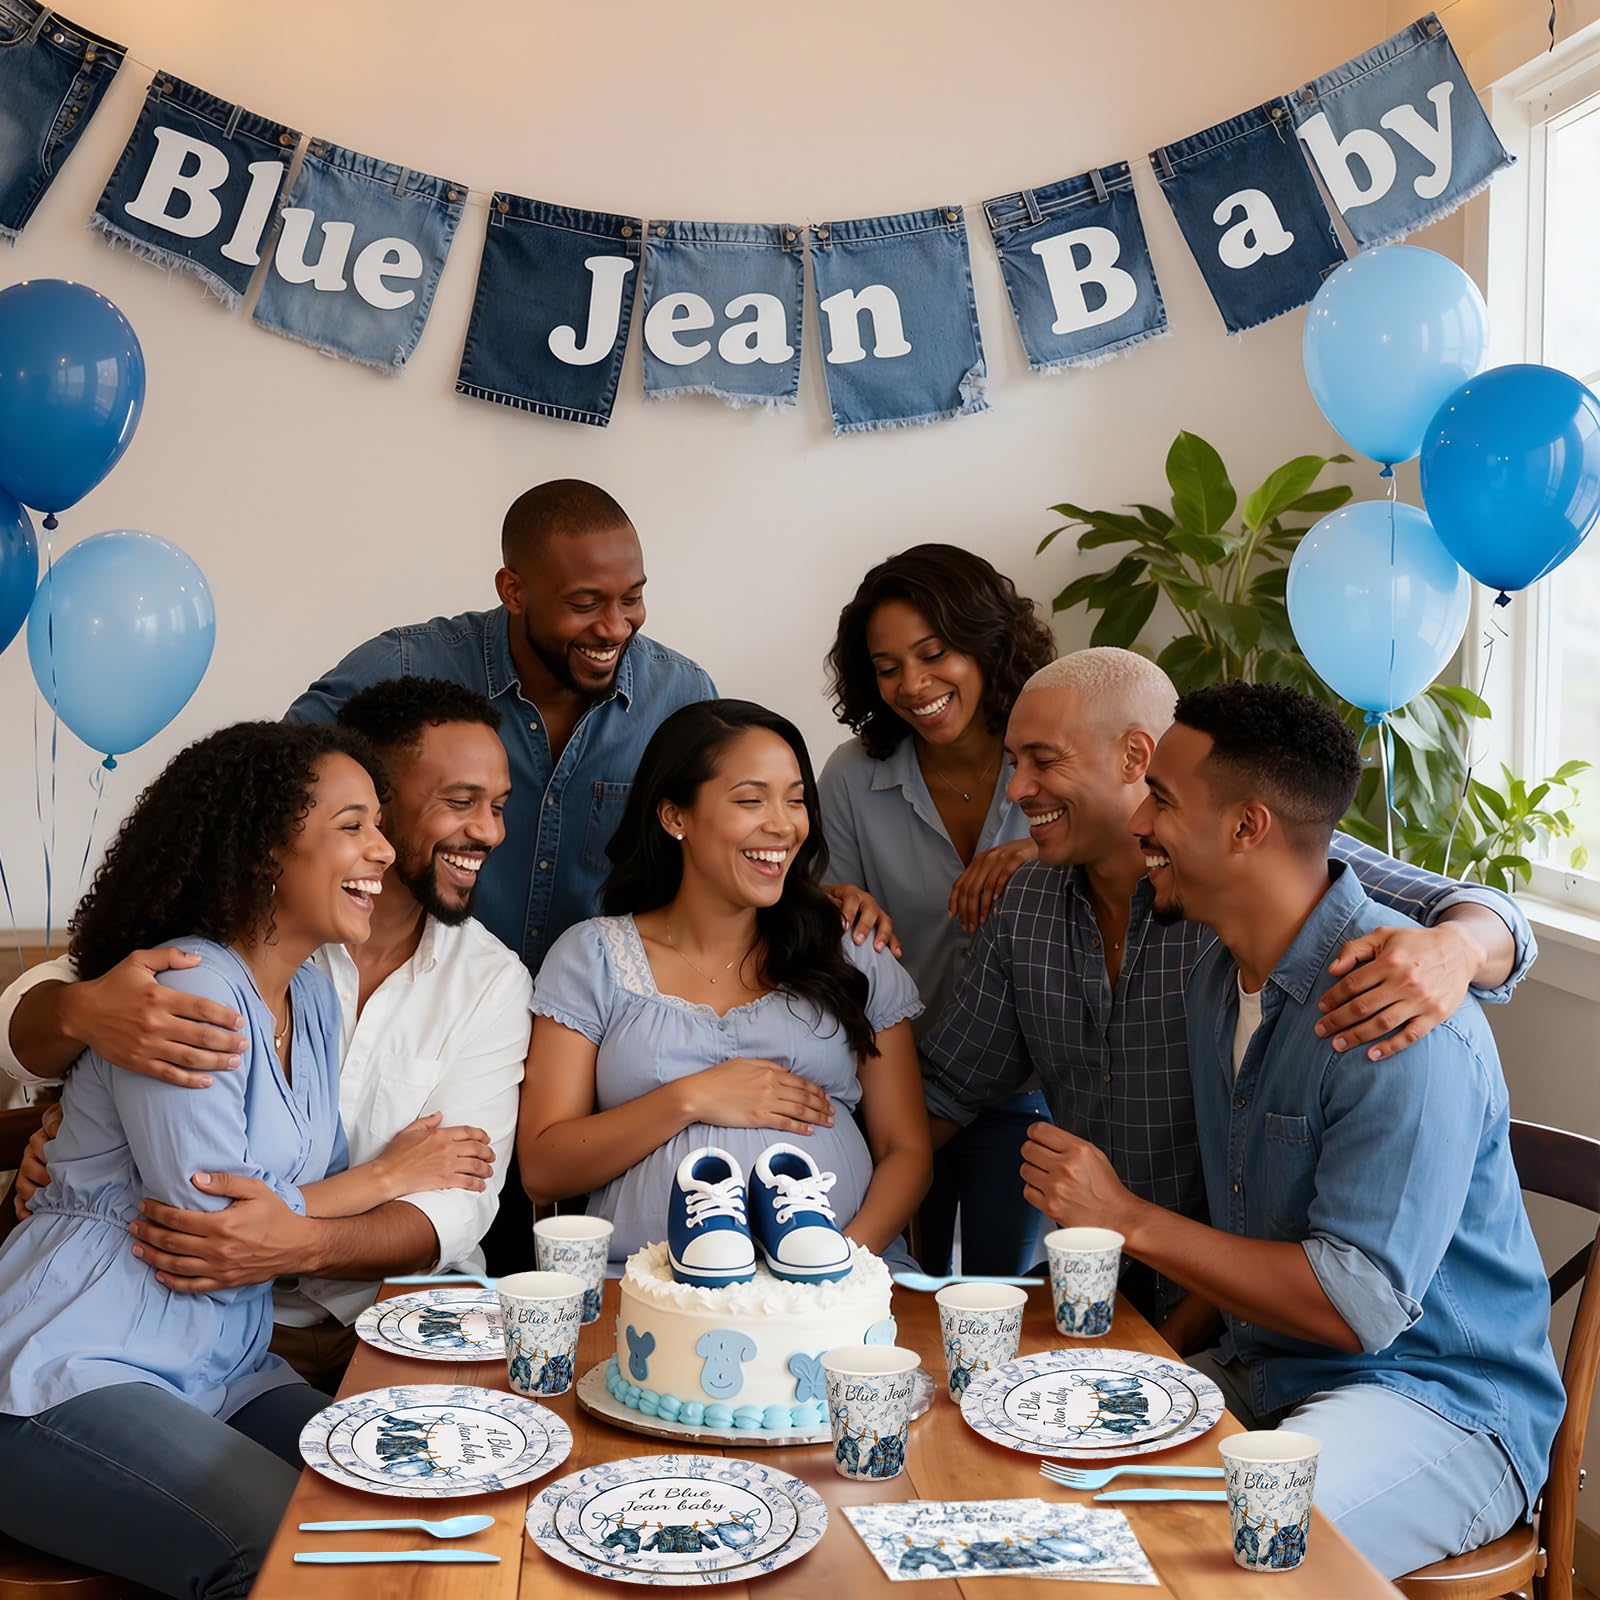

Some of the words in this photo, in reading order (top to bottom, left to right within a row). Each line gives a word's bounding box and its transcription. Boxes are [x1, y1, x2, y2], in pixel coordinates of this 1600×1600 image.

[124, 126, 424, 310] Blue
[548, 255, 912, 366] Jean
[1031, 81, 1454, 336] Baby
[553, 1247, 581, 1262] Blue
[1064, 1259, 1090, 1274] Blue
[505, 1306, 514, 1321] A
[518, 1308, 549, 1325] Blue
[554, 1305, 579, 1324] Jean
[945, 1317, 954, 1332] A
[958, 1319, 989, 1336] Blue
[994, 1316, 1019, 1336] Jean
[831, 1381, 841, 1398] A
[845, 1384, 879, 1402] Blue
[884, 1382, 913, 1402] Jean
[1018, 1391, 1041, 1410] Blue
[1046, 1387, 1073, 1406] baby
[1017, 1413, 1039, 1421] A
[1043, 1407, 1067, 1428] Jean
[456, 1422, 479, 1441] Jean
[484, 1428, 508, 1436] A
[458, 1443, 486, 1465] baby
[487, 1438, 513, 1459] Blue
[1230, 1470, 1240, 1486] A
[1244, 1471, 1280, 1490] Blue
[1285, 1470, 1313, 1490] Jean
[638, 1488, 657, 1499] A
[664, 1487, 711, 1499] Blue
[621, 1500, 671, 1512] Jean
[677, 1499, 726, 1512] baby
